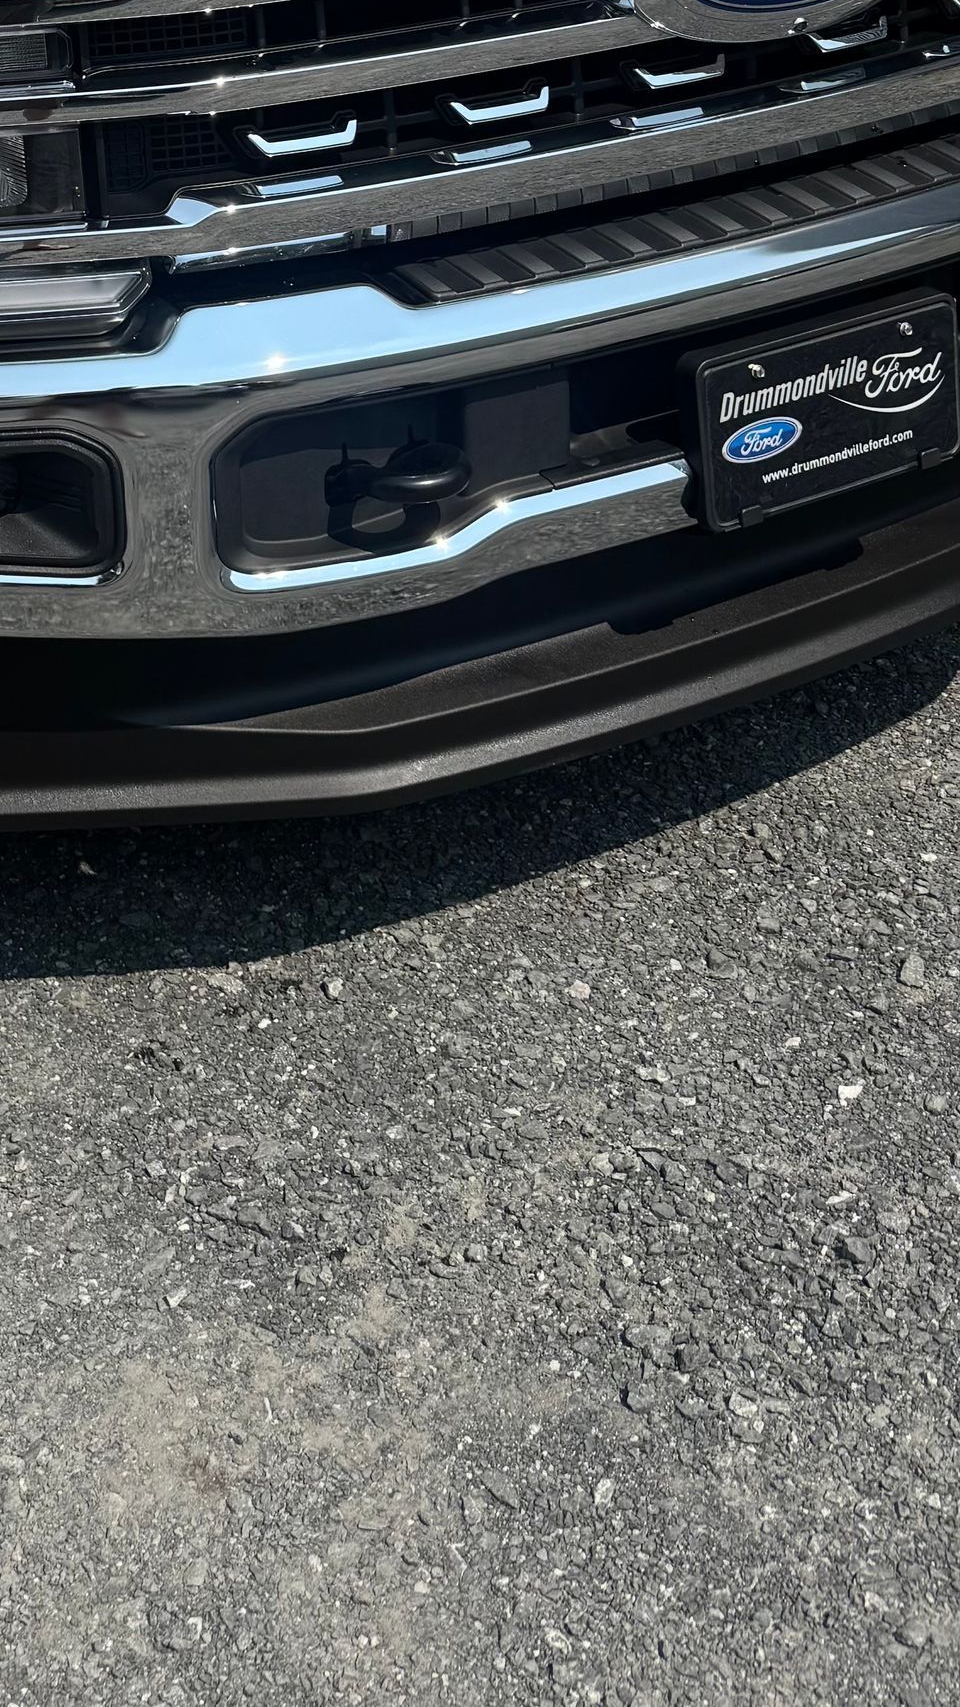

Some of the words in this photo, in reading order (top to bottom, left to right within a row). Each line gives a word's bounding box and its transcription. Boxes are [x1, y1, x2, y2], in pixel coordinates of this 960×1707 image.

[719, 355, 867, 423] Drummondville
[864, 347, 943, 399] Ford
[741, 426, 784, 456] Ford
[762, 429, 913, 484] www.drummondvilleford.com
